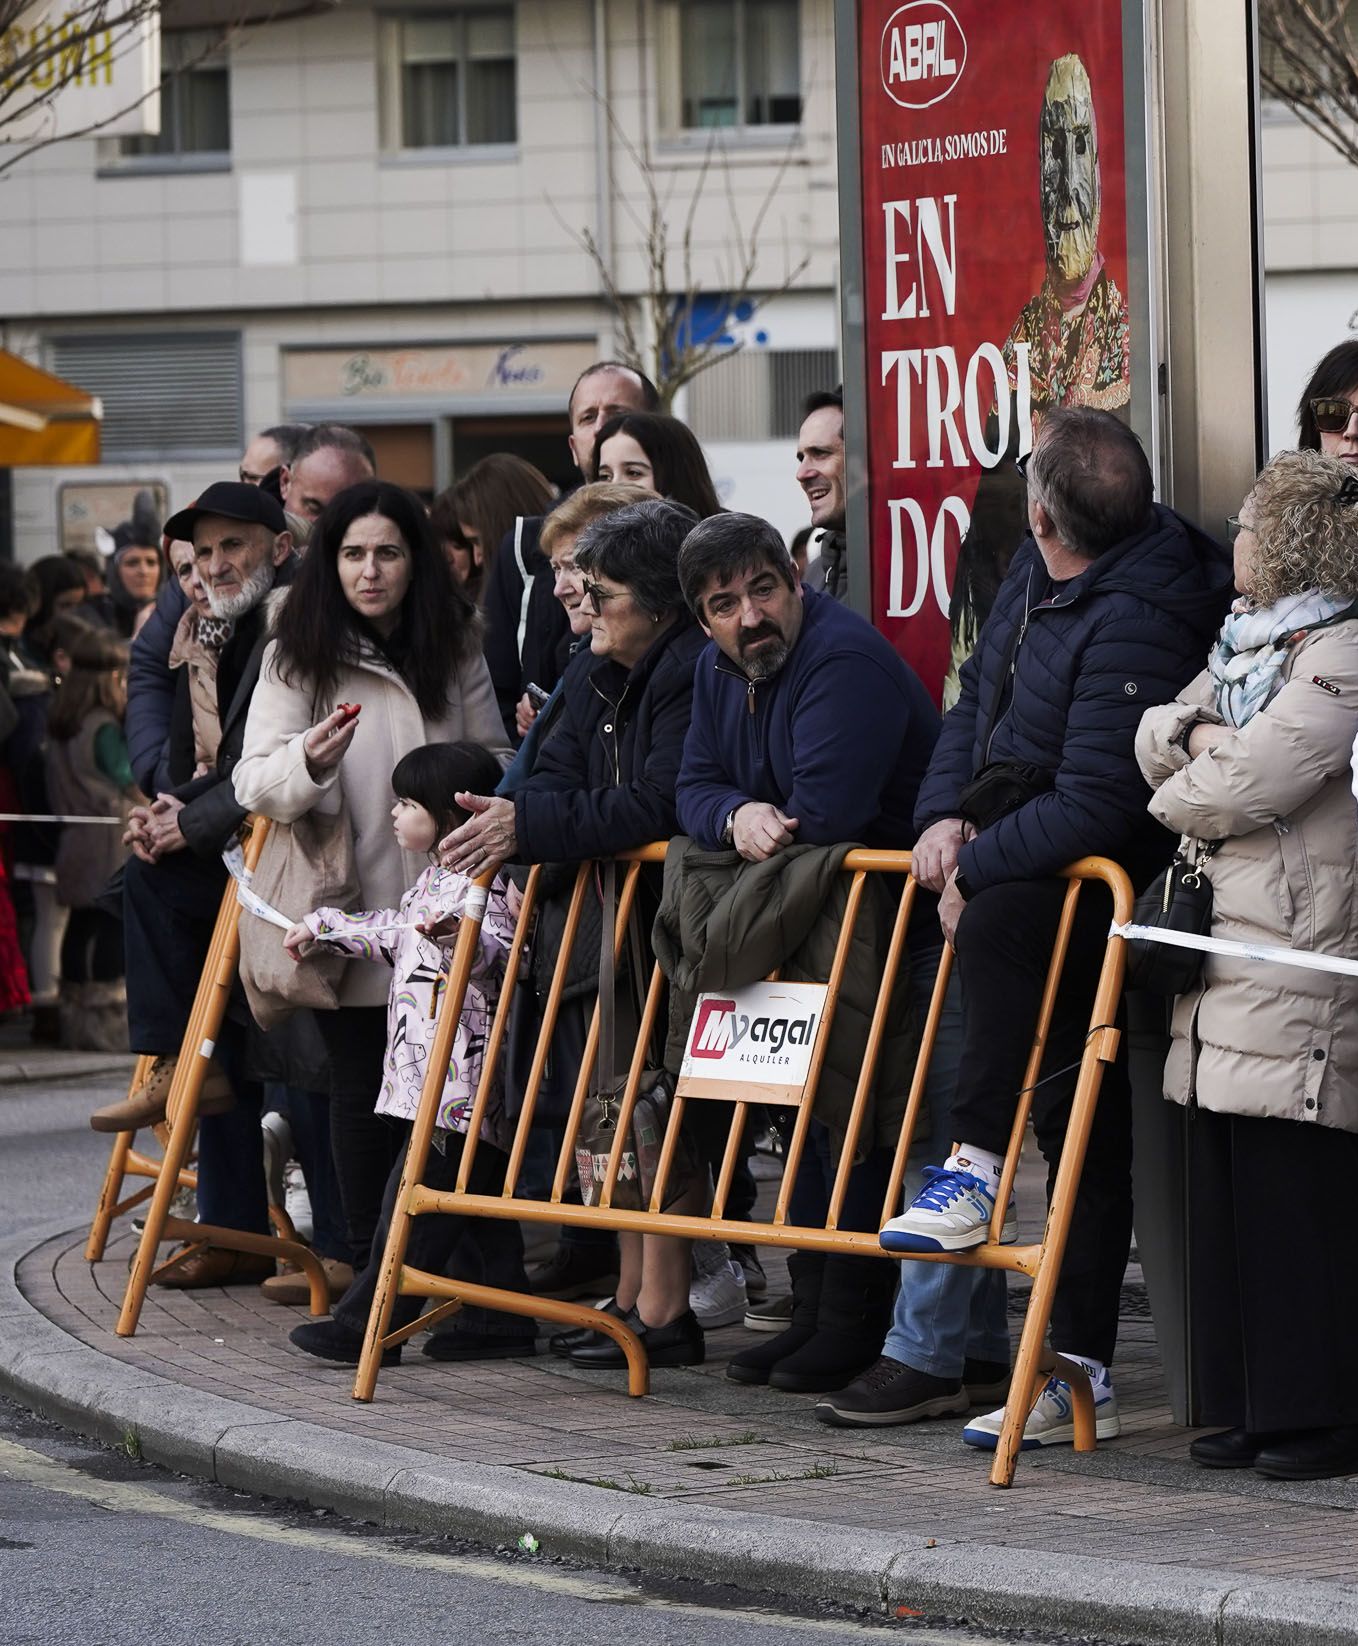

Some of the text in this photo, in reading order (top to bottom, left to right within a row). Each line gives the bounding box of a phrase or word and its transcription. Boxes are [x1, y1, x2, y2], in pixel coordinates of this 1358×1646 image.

[888, 19, 957, 84] ABRIL
[881, 128, 1007, 169] EN GALICIA, SOMOS DE
[881, 194, 957, 320] EN
[697, 1010, 816, 1053] Myagal
[740, 1054, 790, 1065] ALQUILER
